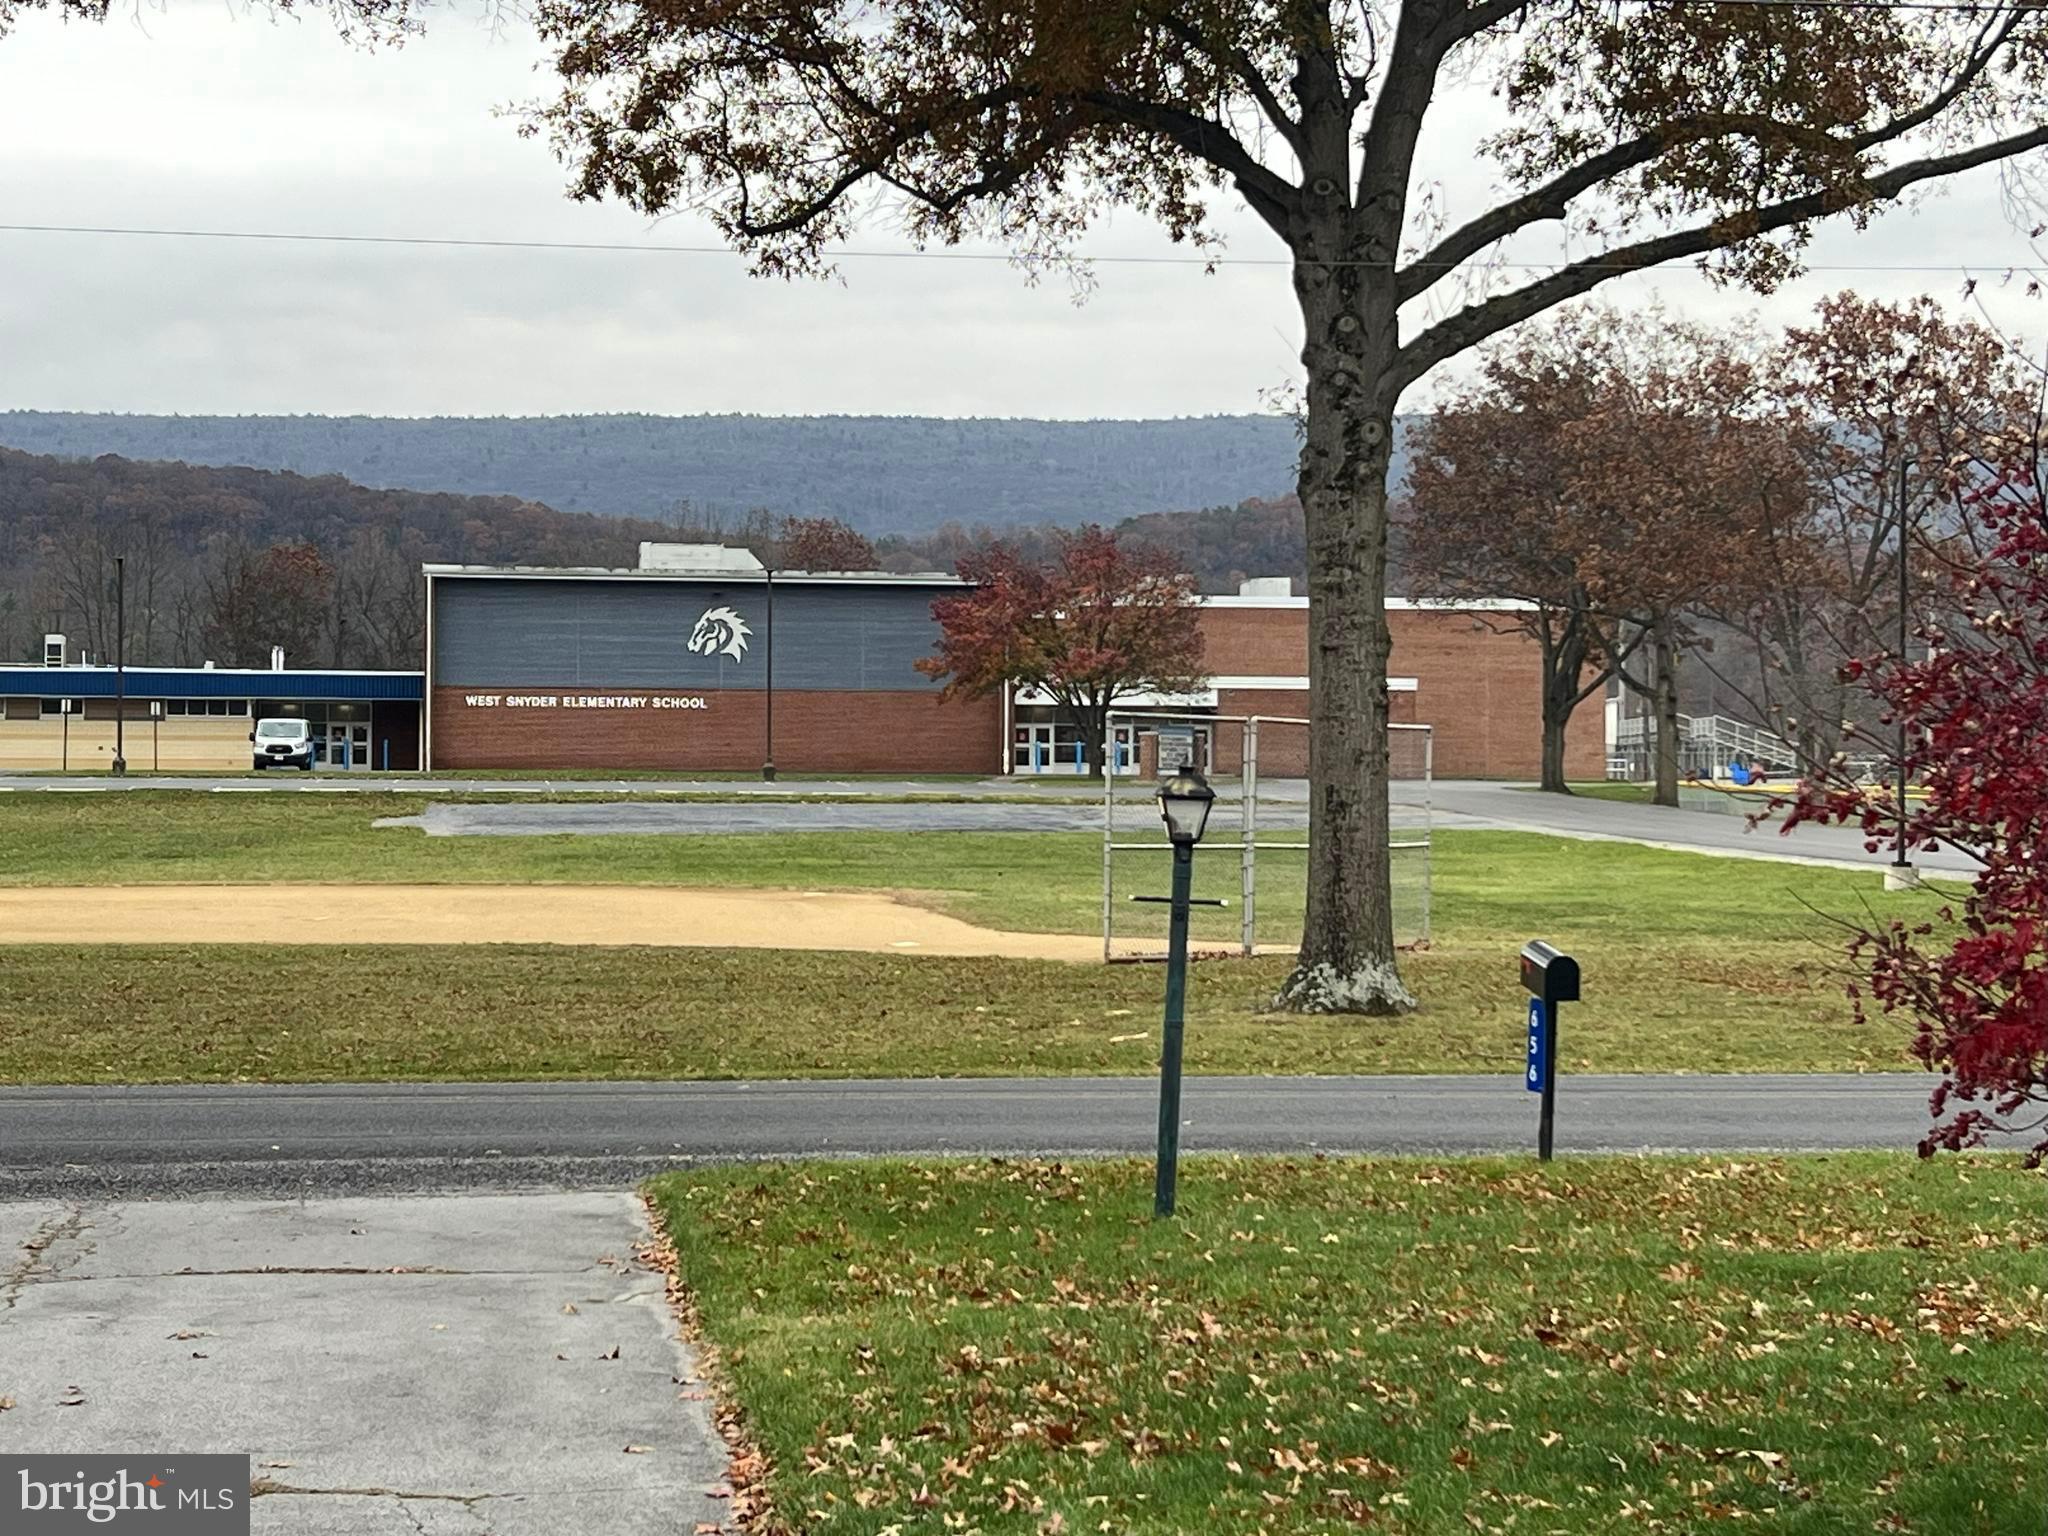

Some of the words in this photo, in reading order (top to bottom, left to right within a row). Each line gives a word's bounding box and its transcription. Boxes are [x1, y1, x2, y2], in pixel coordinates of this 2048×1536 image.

[465, 695, 501, 707] WEST
[505, 695, 557, 708] SNYDER
[562, 696, 648, 708] ELEMENTARY
[651, 697, 708, 709] SCHOOL
[1528, 1009, 1539, 1082] 656
